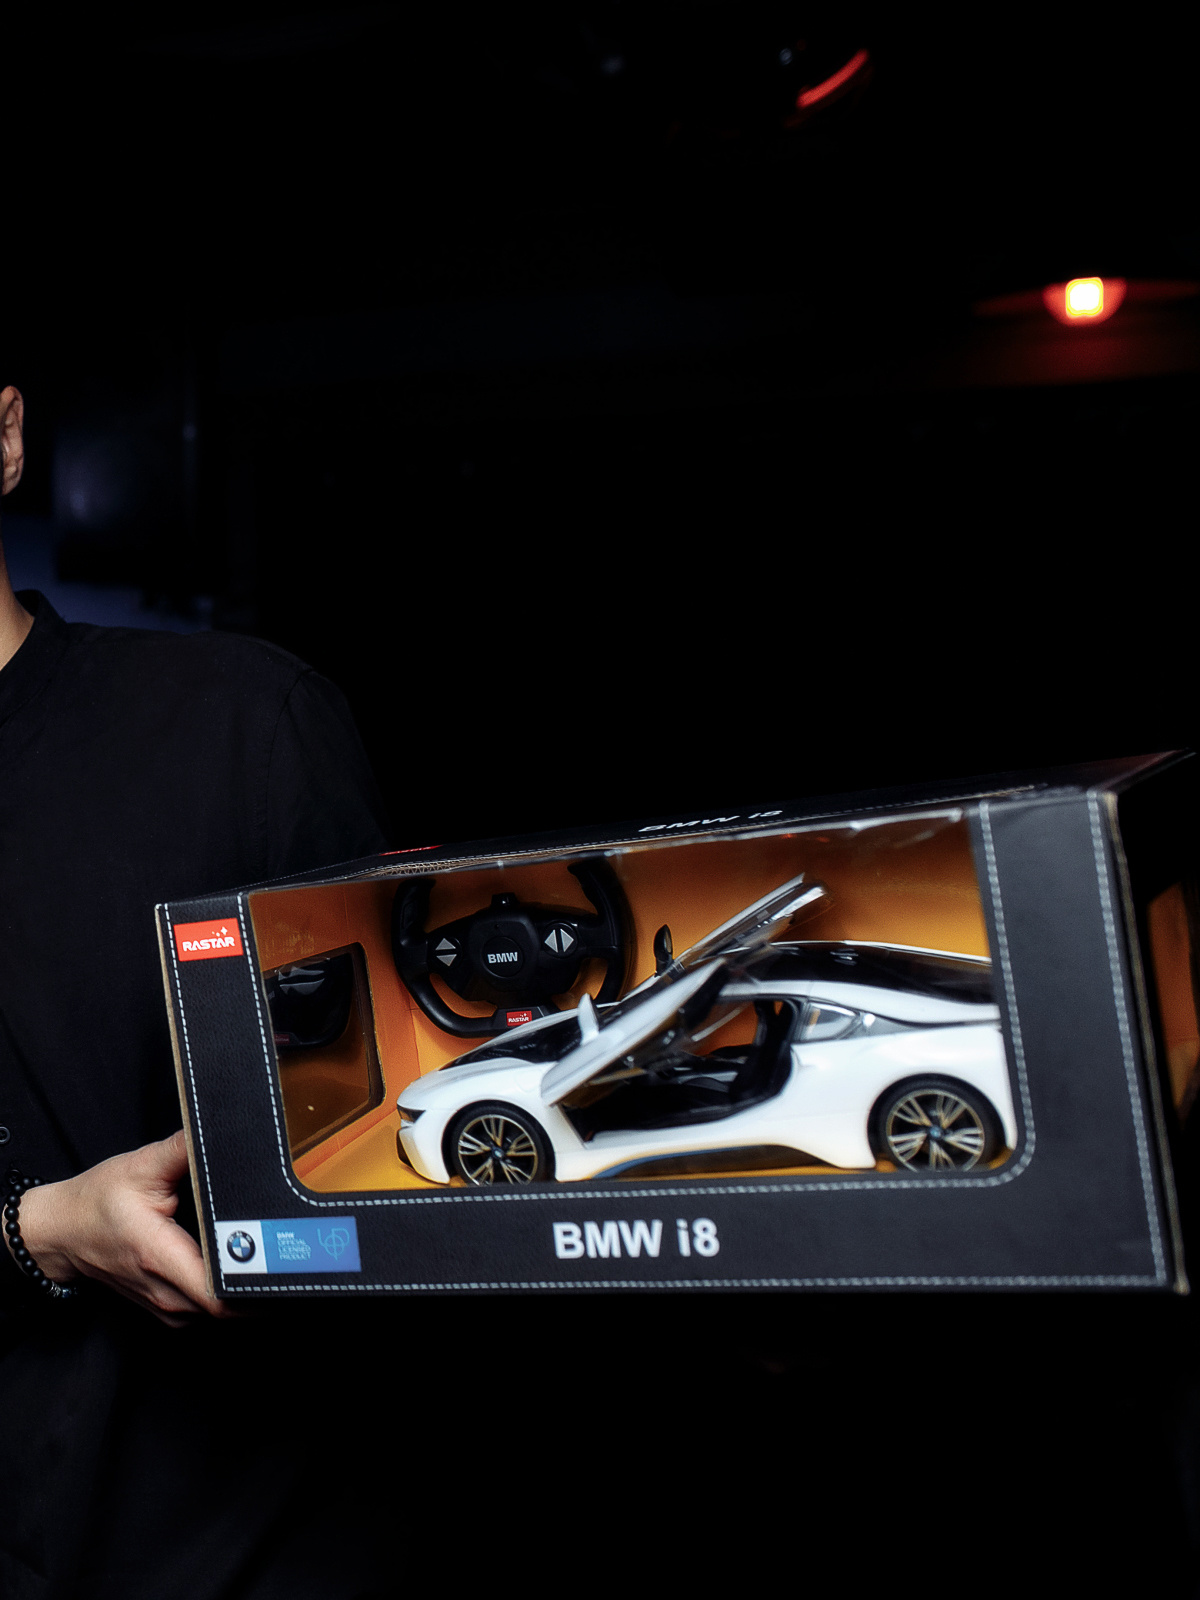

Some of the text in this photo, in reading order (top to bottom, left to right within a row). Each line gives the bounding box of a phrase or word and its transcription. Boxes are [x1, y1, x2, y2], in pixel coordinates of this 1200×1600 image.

[182, 936, 235, 952] RASTAR
[487, 952, 518, 964] BMW
[508, 1016, 529, 1024] RASTAR
[276, 1232, 295, 1240] BMW
[552, 1217, 720, 1259] BMW i8
